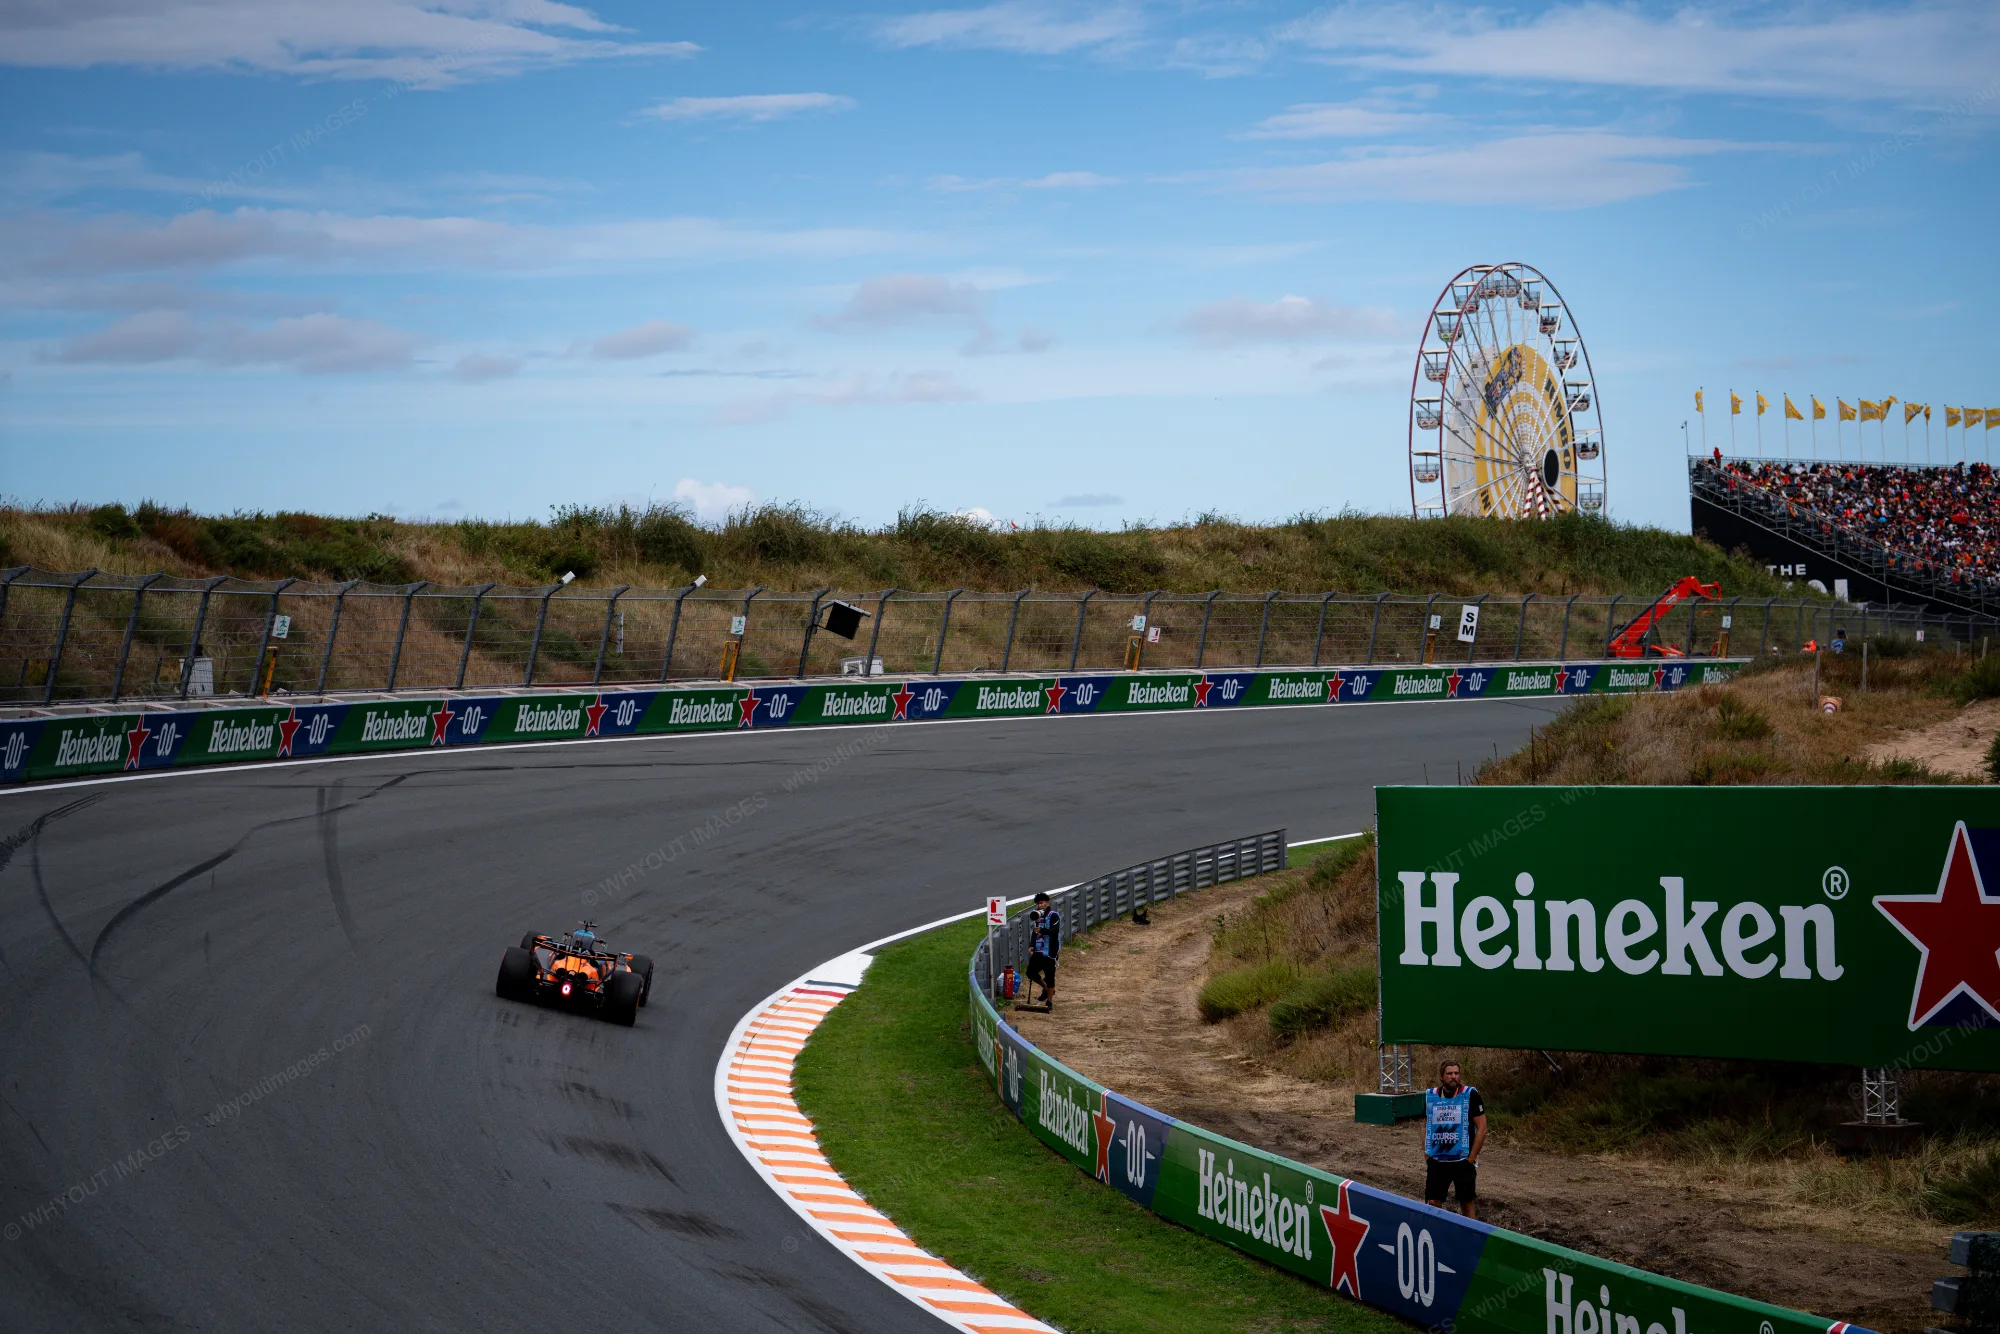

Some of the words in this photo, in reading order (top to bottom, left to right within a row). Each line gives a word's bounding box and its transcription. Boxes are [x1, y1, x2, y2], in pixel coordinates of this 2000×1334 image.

[1765, 564, 1807, 576] THE
[1465, 612, 1475, 623] S
[1462, 624, 1475, 636] M
[1039, 1069, 1089, 1156] Heineken
[1127, 1120, 1146, 1188] 0.0
[1432, 1132, 1460, 1140] COURSE
[1198, 1148, 1313, 1261] Heineken
[1398, 1222, 1435, 1307] 0.0
